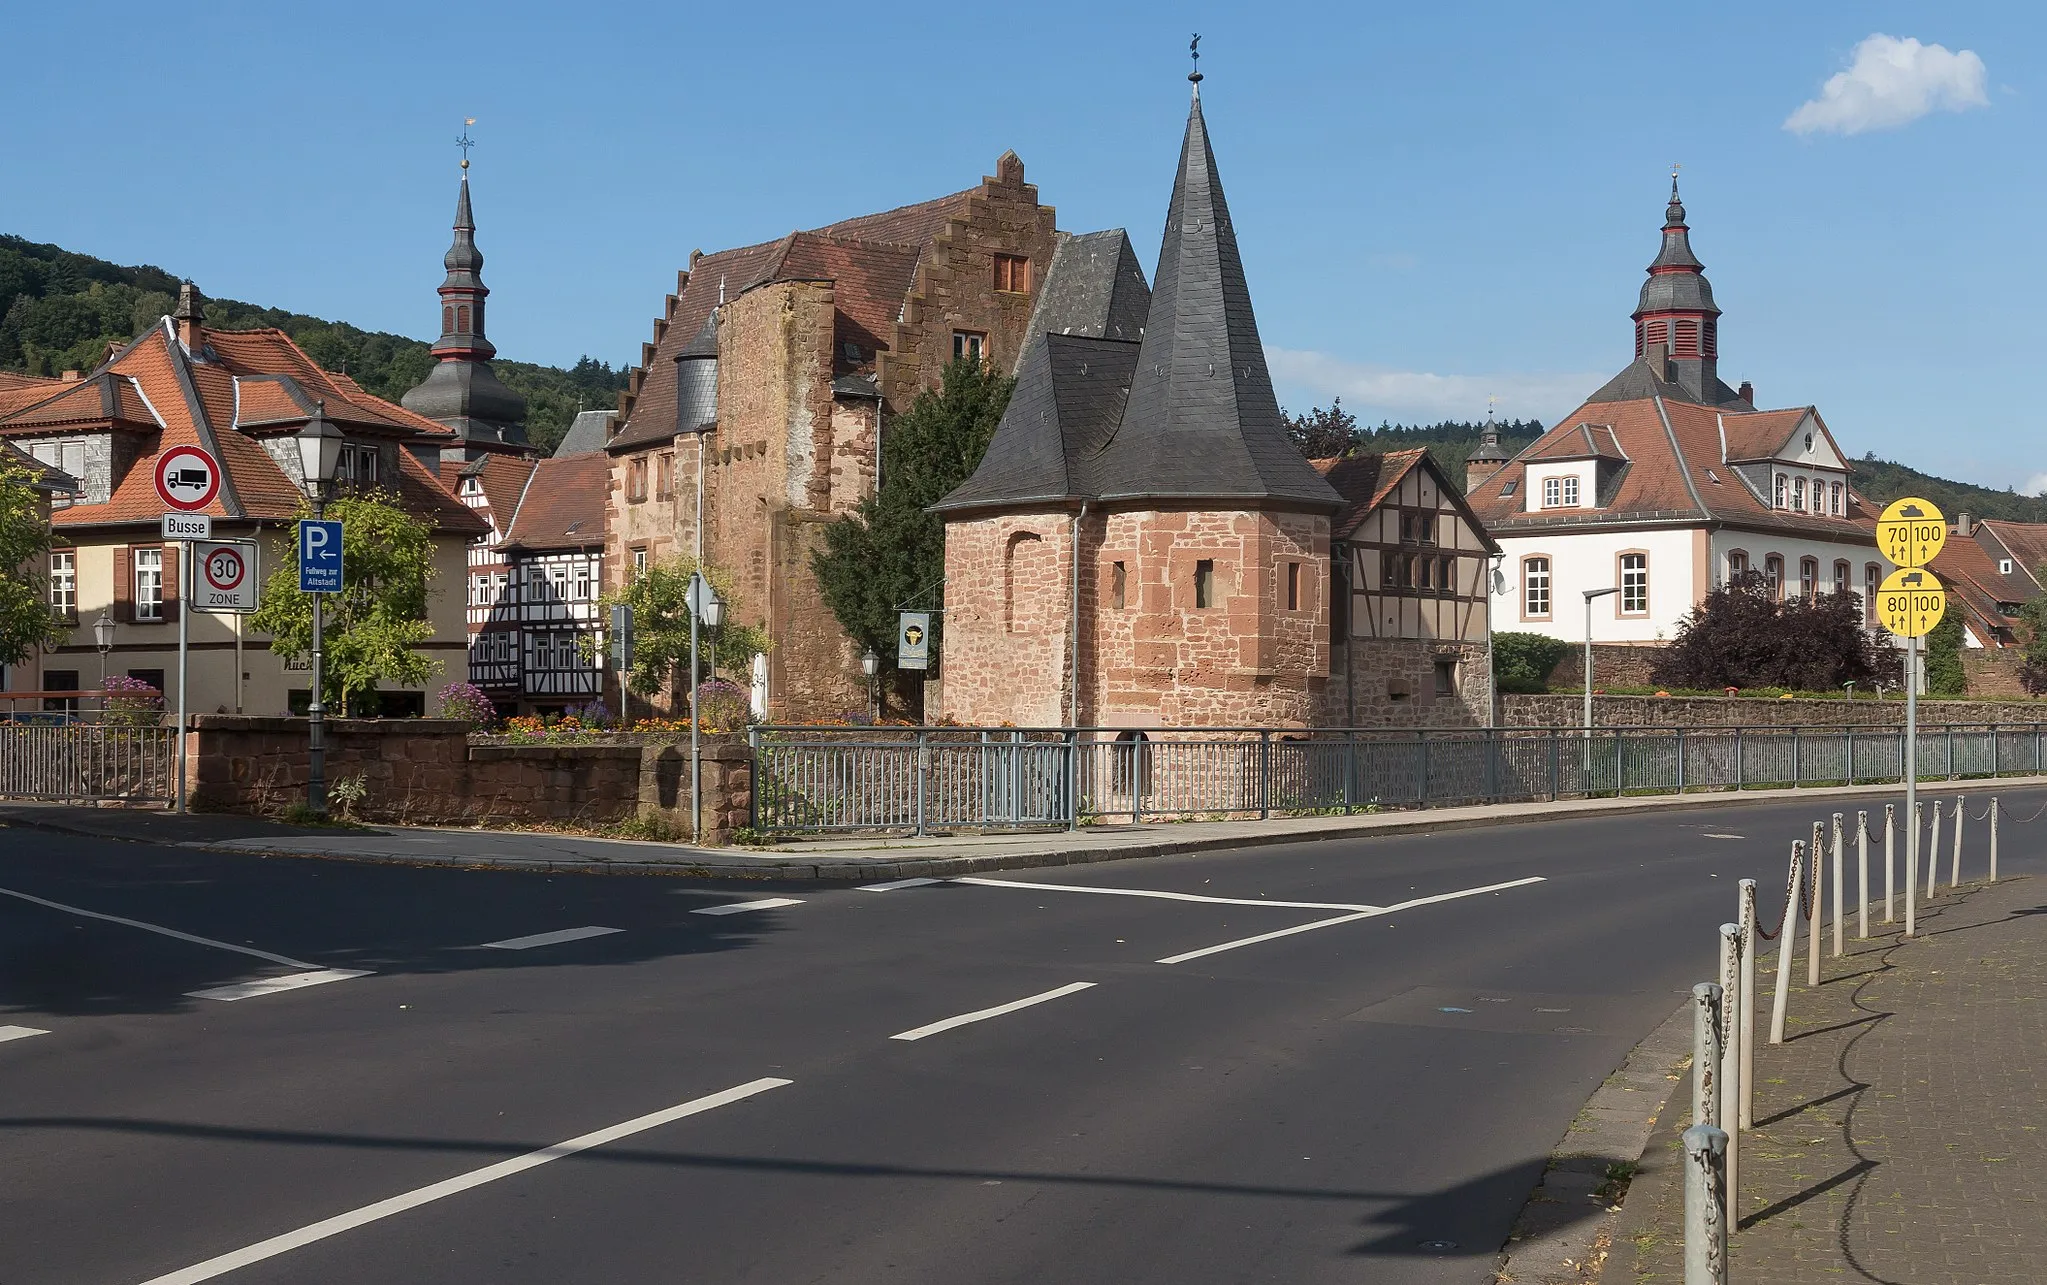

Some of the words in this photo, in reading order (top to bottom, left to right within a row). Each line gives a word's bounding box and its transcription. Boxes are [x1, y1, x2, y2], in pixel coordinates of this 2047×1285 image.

[168, 518, 205, 534] Busse
[1888, 527, 1908, 543] 70
[1914, 526, 1941, 542] 100
[306, 526, 329, 560] P
[213, 559, 237, 579] 30
[305, 567, 327, 577] Fußweg
[307, 578, 337, 586] Altstadt
[209, 593, 240, 604] ZONE
[1887, 596, 1907, 612] 80
[1914, 596, 1940, 612] 100
